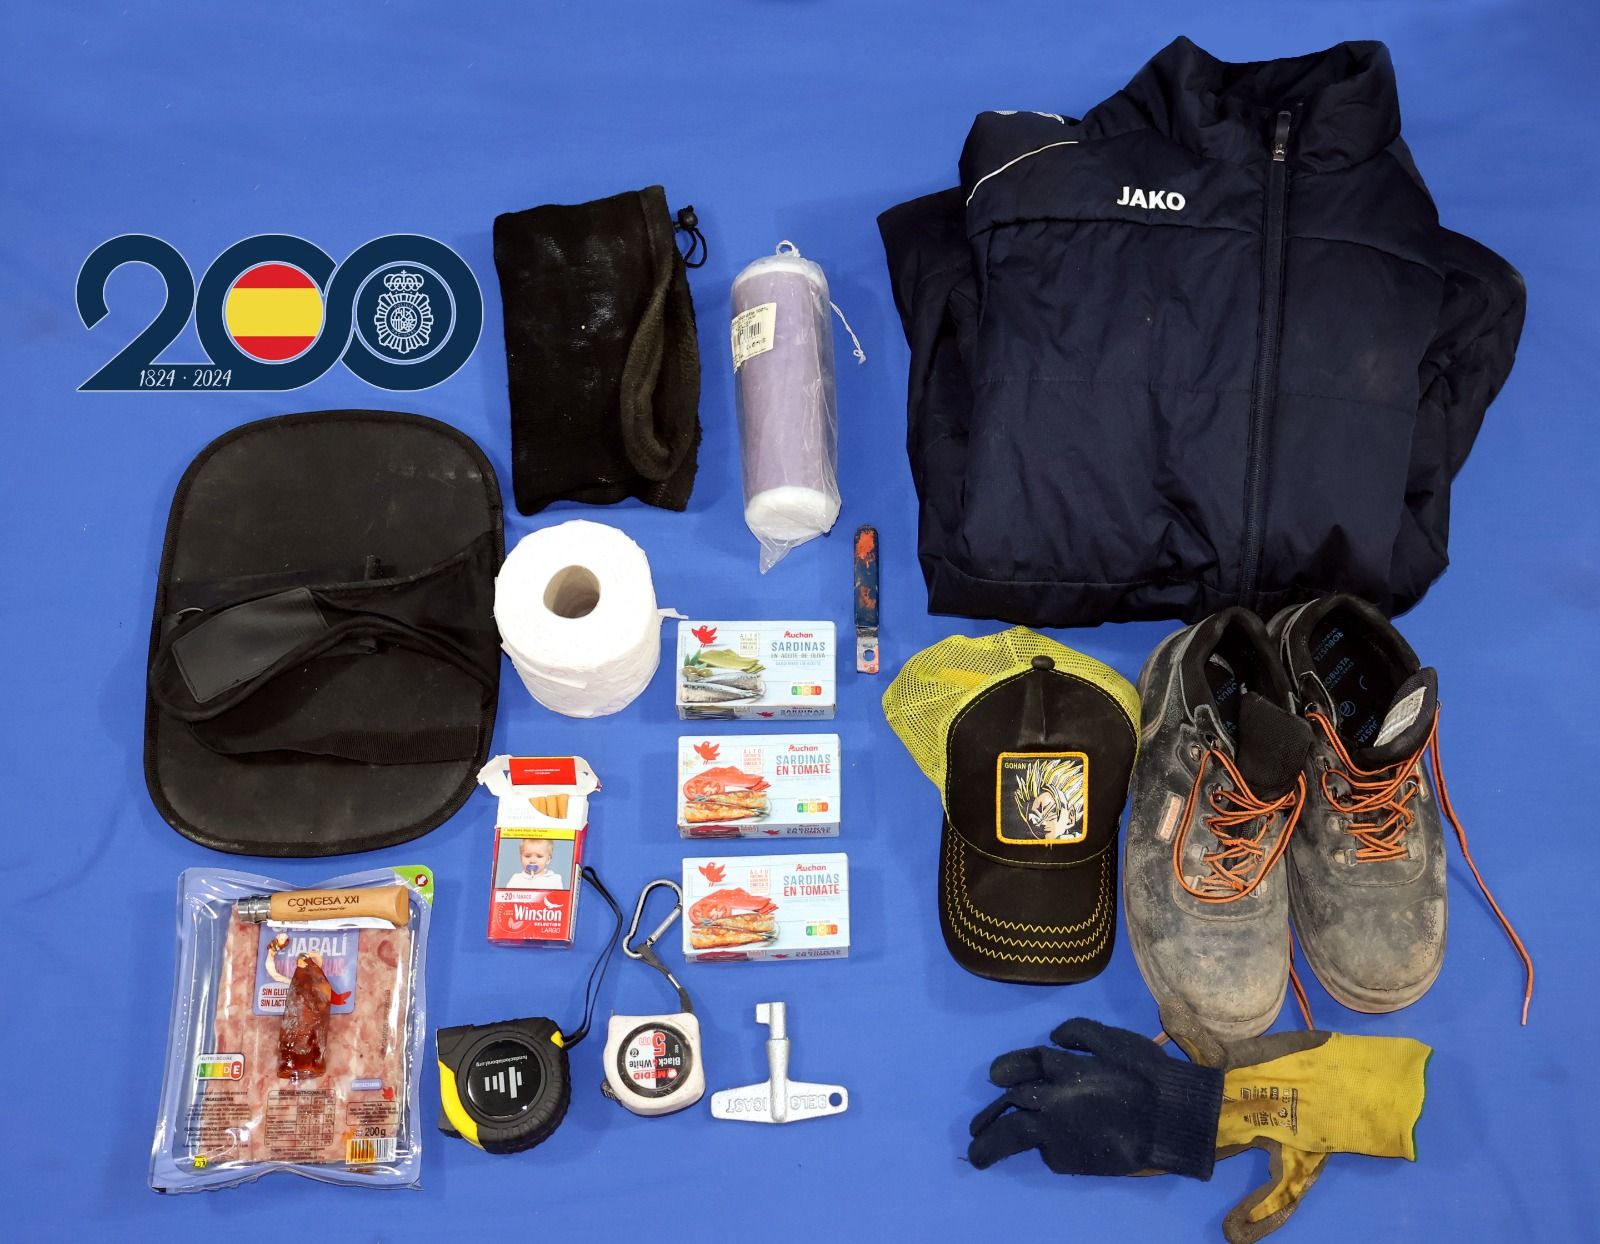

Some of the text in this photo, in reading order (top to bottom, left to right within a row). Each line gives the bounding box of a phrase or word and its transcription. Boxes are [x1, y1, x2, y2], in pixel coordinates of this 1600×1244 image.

[1116, 186, 1186, 211] JAKO
[783, 630, 814, 639] Auchan
[771, 641, 826, 651] SARDINAS
[788, 744, 818, 752] Auchan
[776, 753, 831, 766] SARDINAS
[776, 764, 831, 776] EN TOMATE
[795, 863, 827, 872] Auchan
[783, 873, 840, 886] SARDINAS
[784, 884, 840, 897] EN TOMATE
[287, 895, 360, 907] CONGESA XXI
[514, 903, 562, 921] Winston
[262, 988, 289, 996] SIN GLUT
[260, 999, 288, 1007] SIN LACT
[233, 1065, 240, 1075] E
